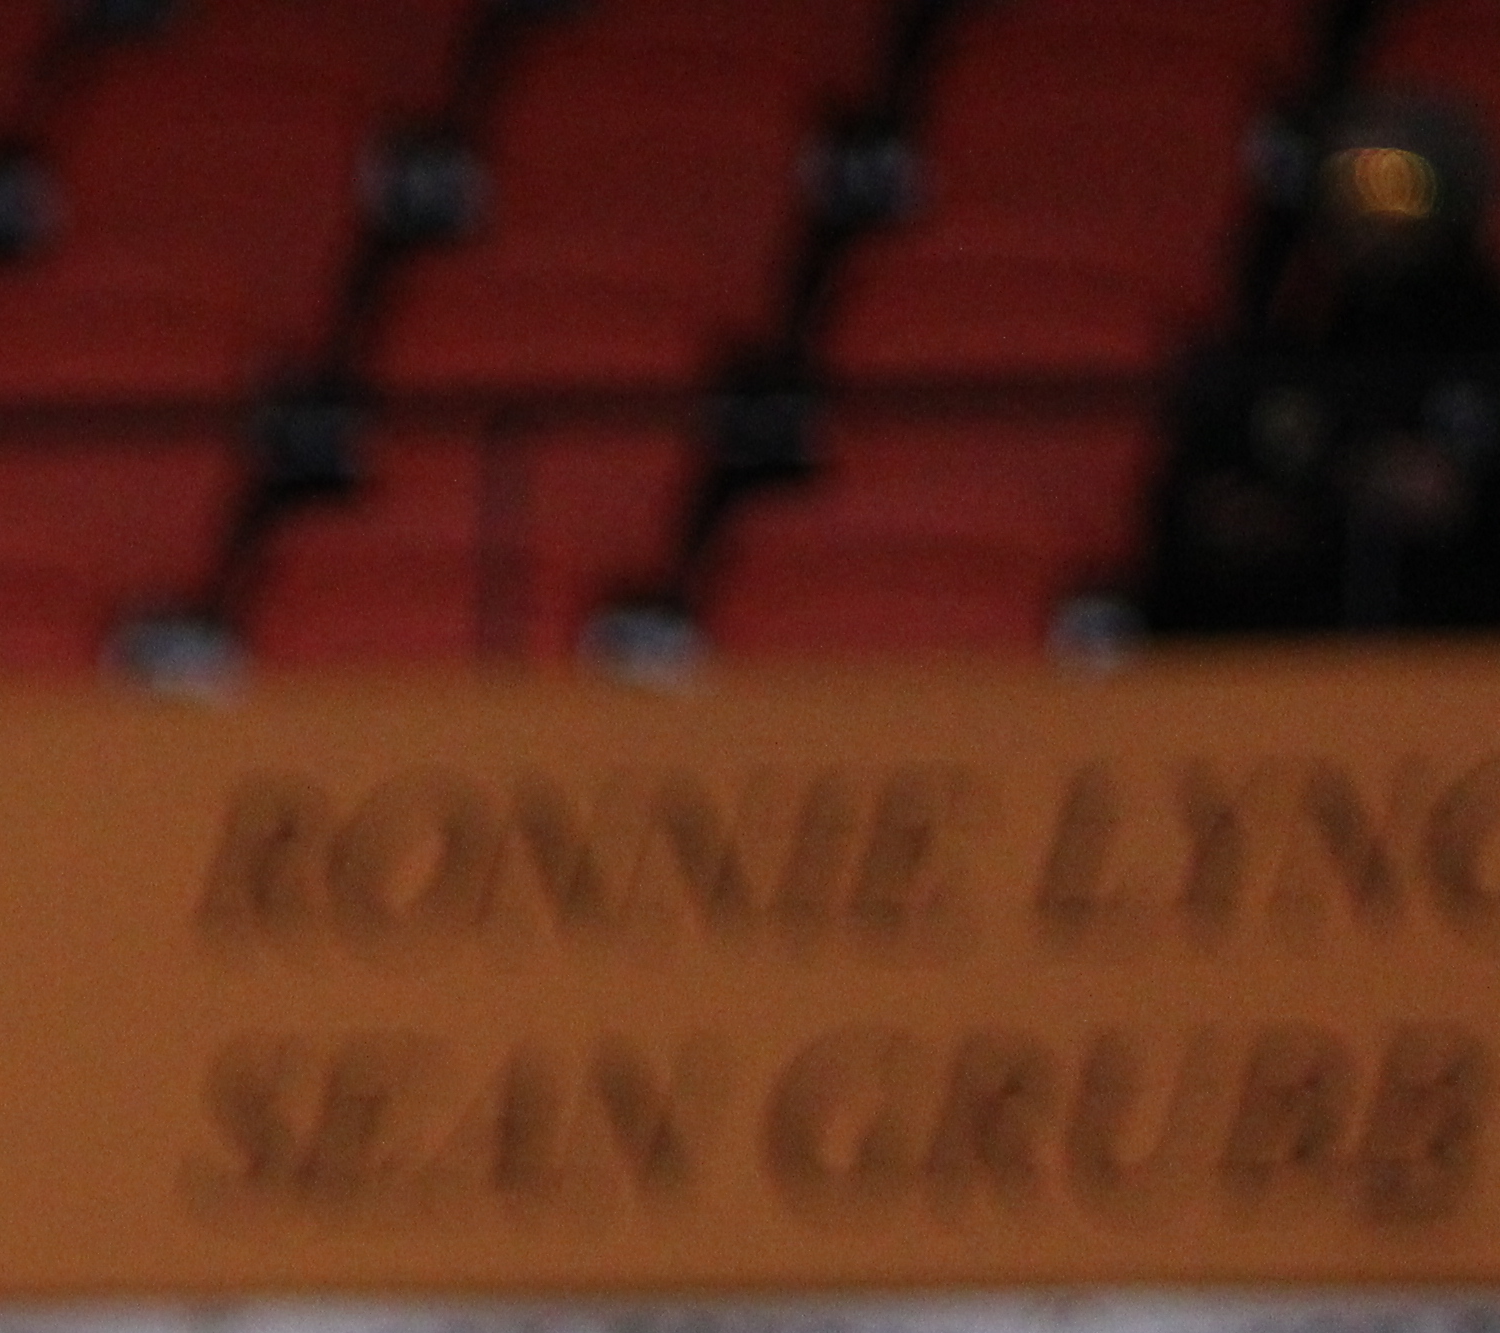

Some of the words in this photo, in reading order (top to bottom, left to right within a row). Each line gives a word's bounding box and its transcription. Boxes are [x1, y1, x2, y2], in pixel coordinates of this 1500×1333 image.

[190, 765, 970, 952] RONNIE
[1035, 755, 1500, 952] LYNC
[180, 1032, 738, 1220] SEAN
[762, 1022, 1498, 1222] GRUBB
